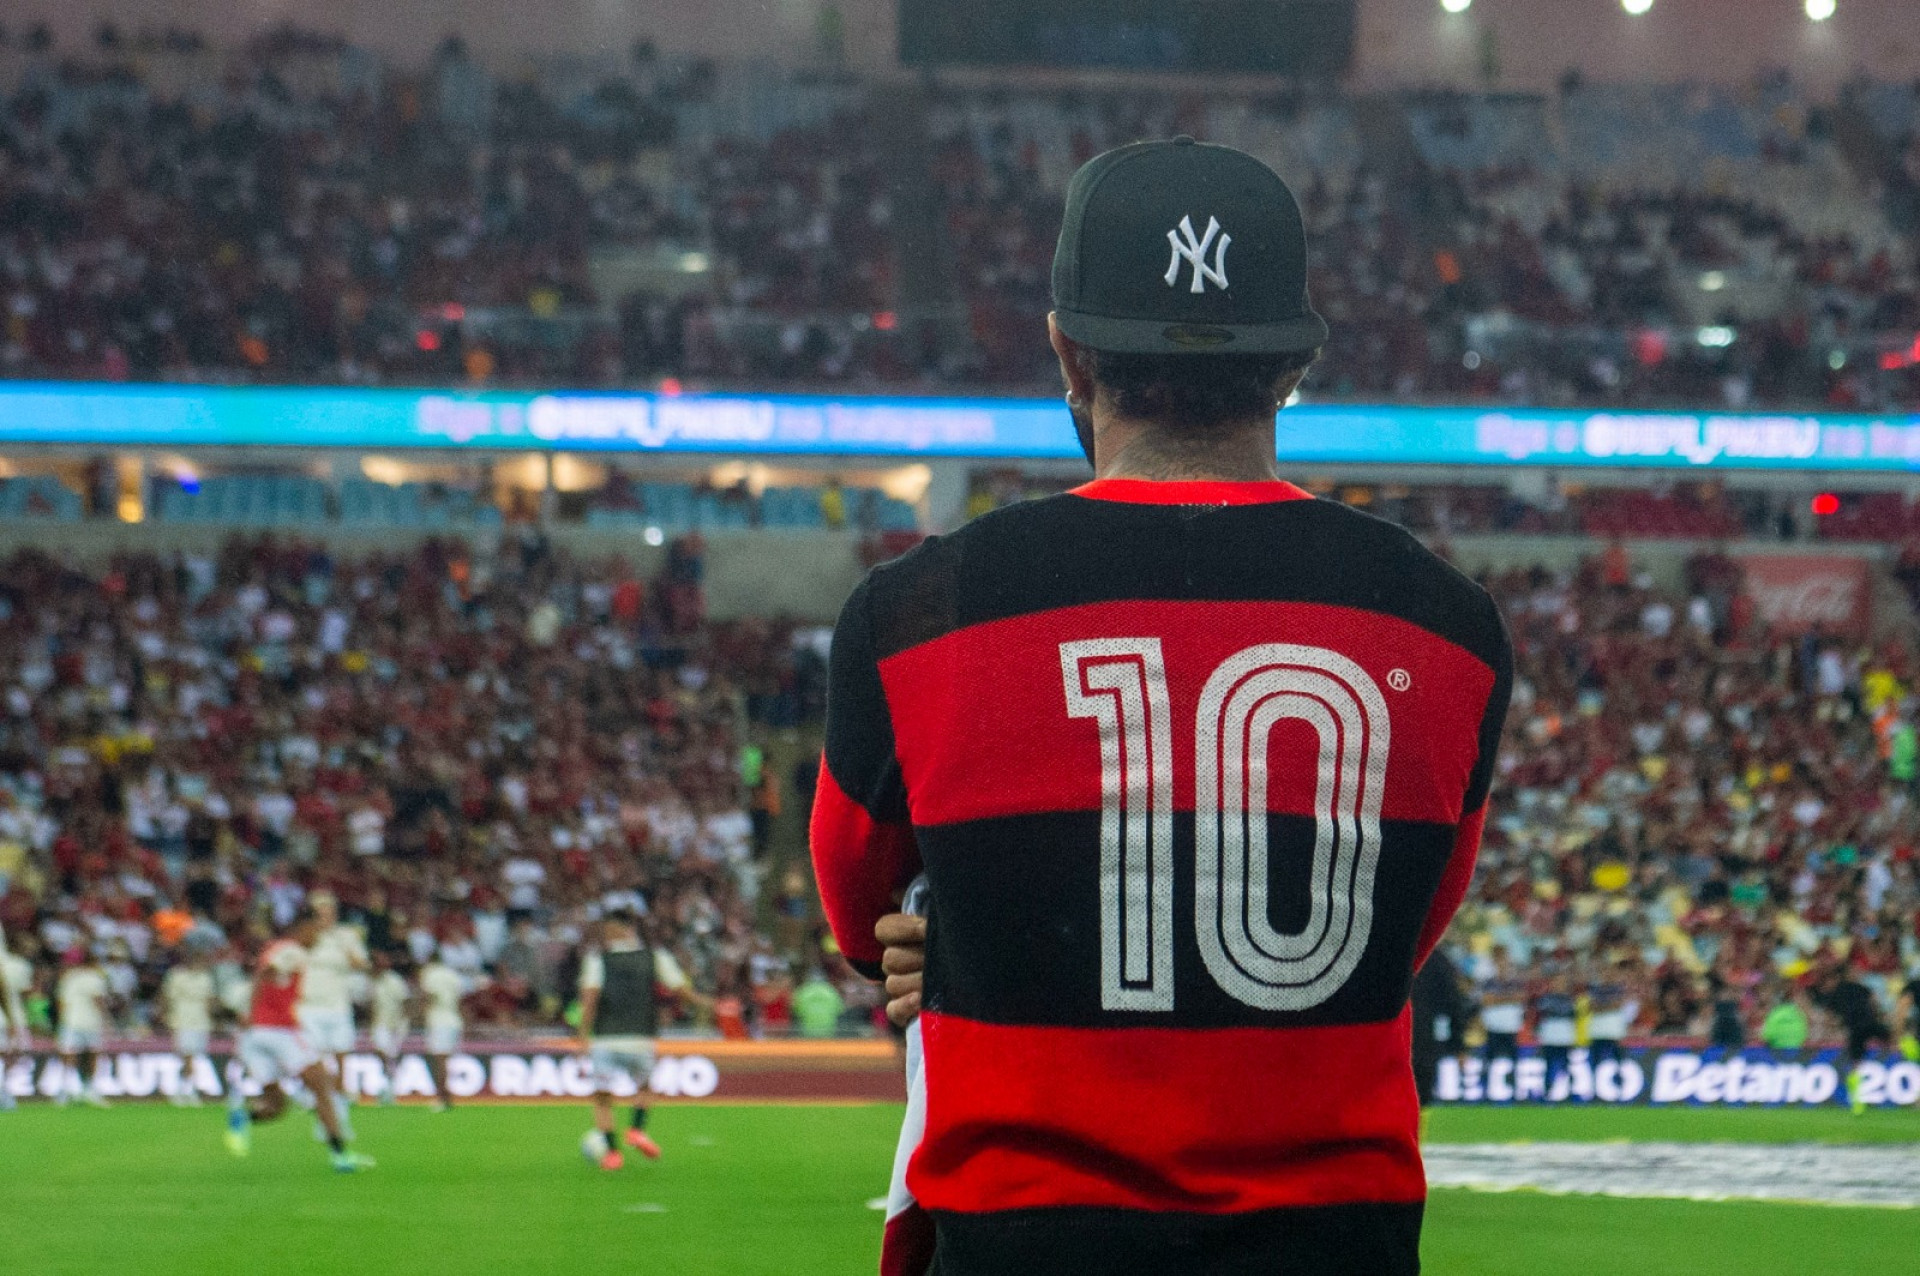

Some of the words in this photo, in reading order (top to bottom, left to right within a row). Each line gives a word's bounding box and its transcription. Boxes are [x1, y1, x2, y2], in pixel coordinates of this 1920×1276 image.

[1058, 637, 1391, 1012] 10
[93, 1053, 223, 1096] LUTA
[1650, 1053, 1840, 1103] Betano
